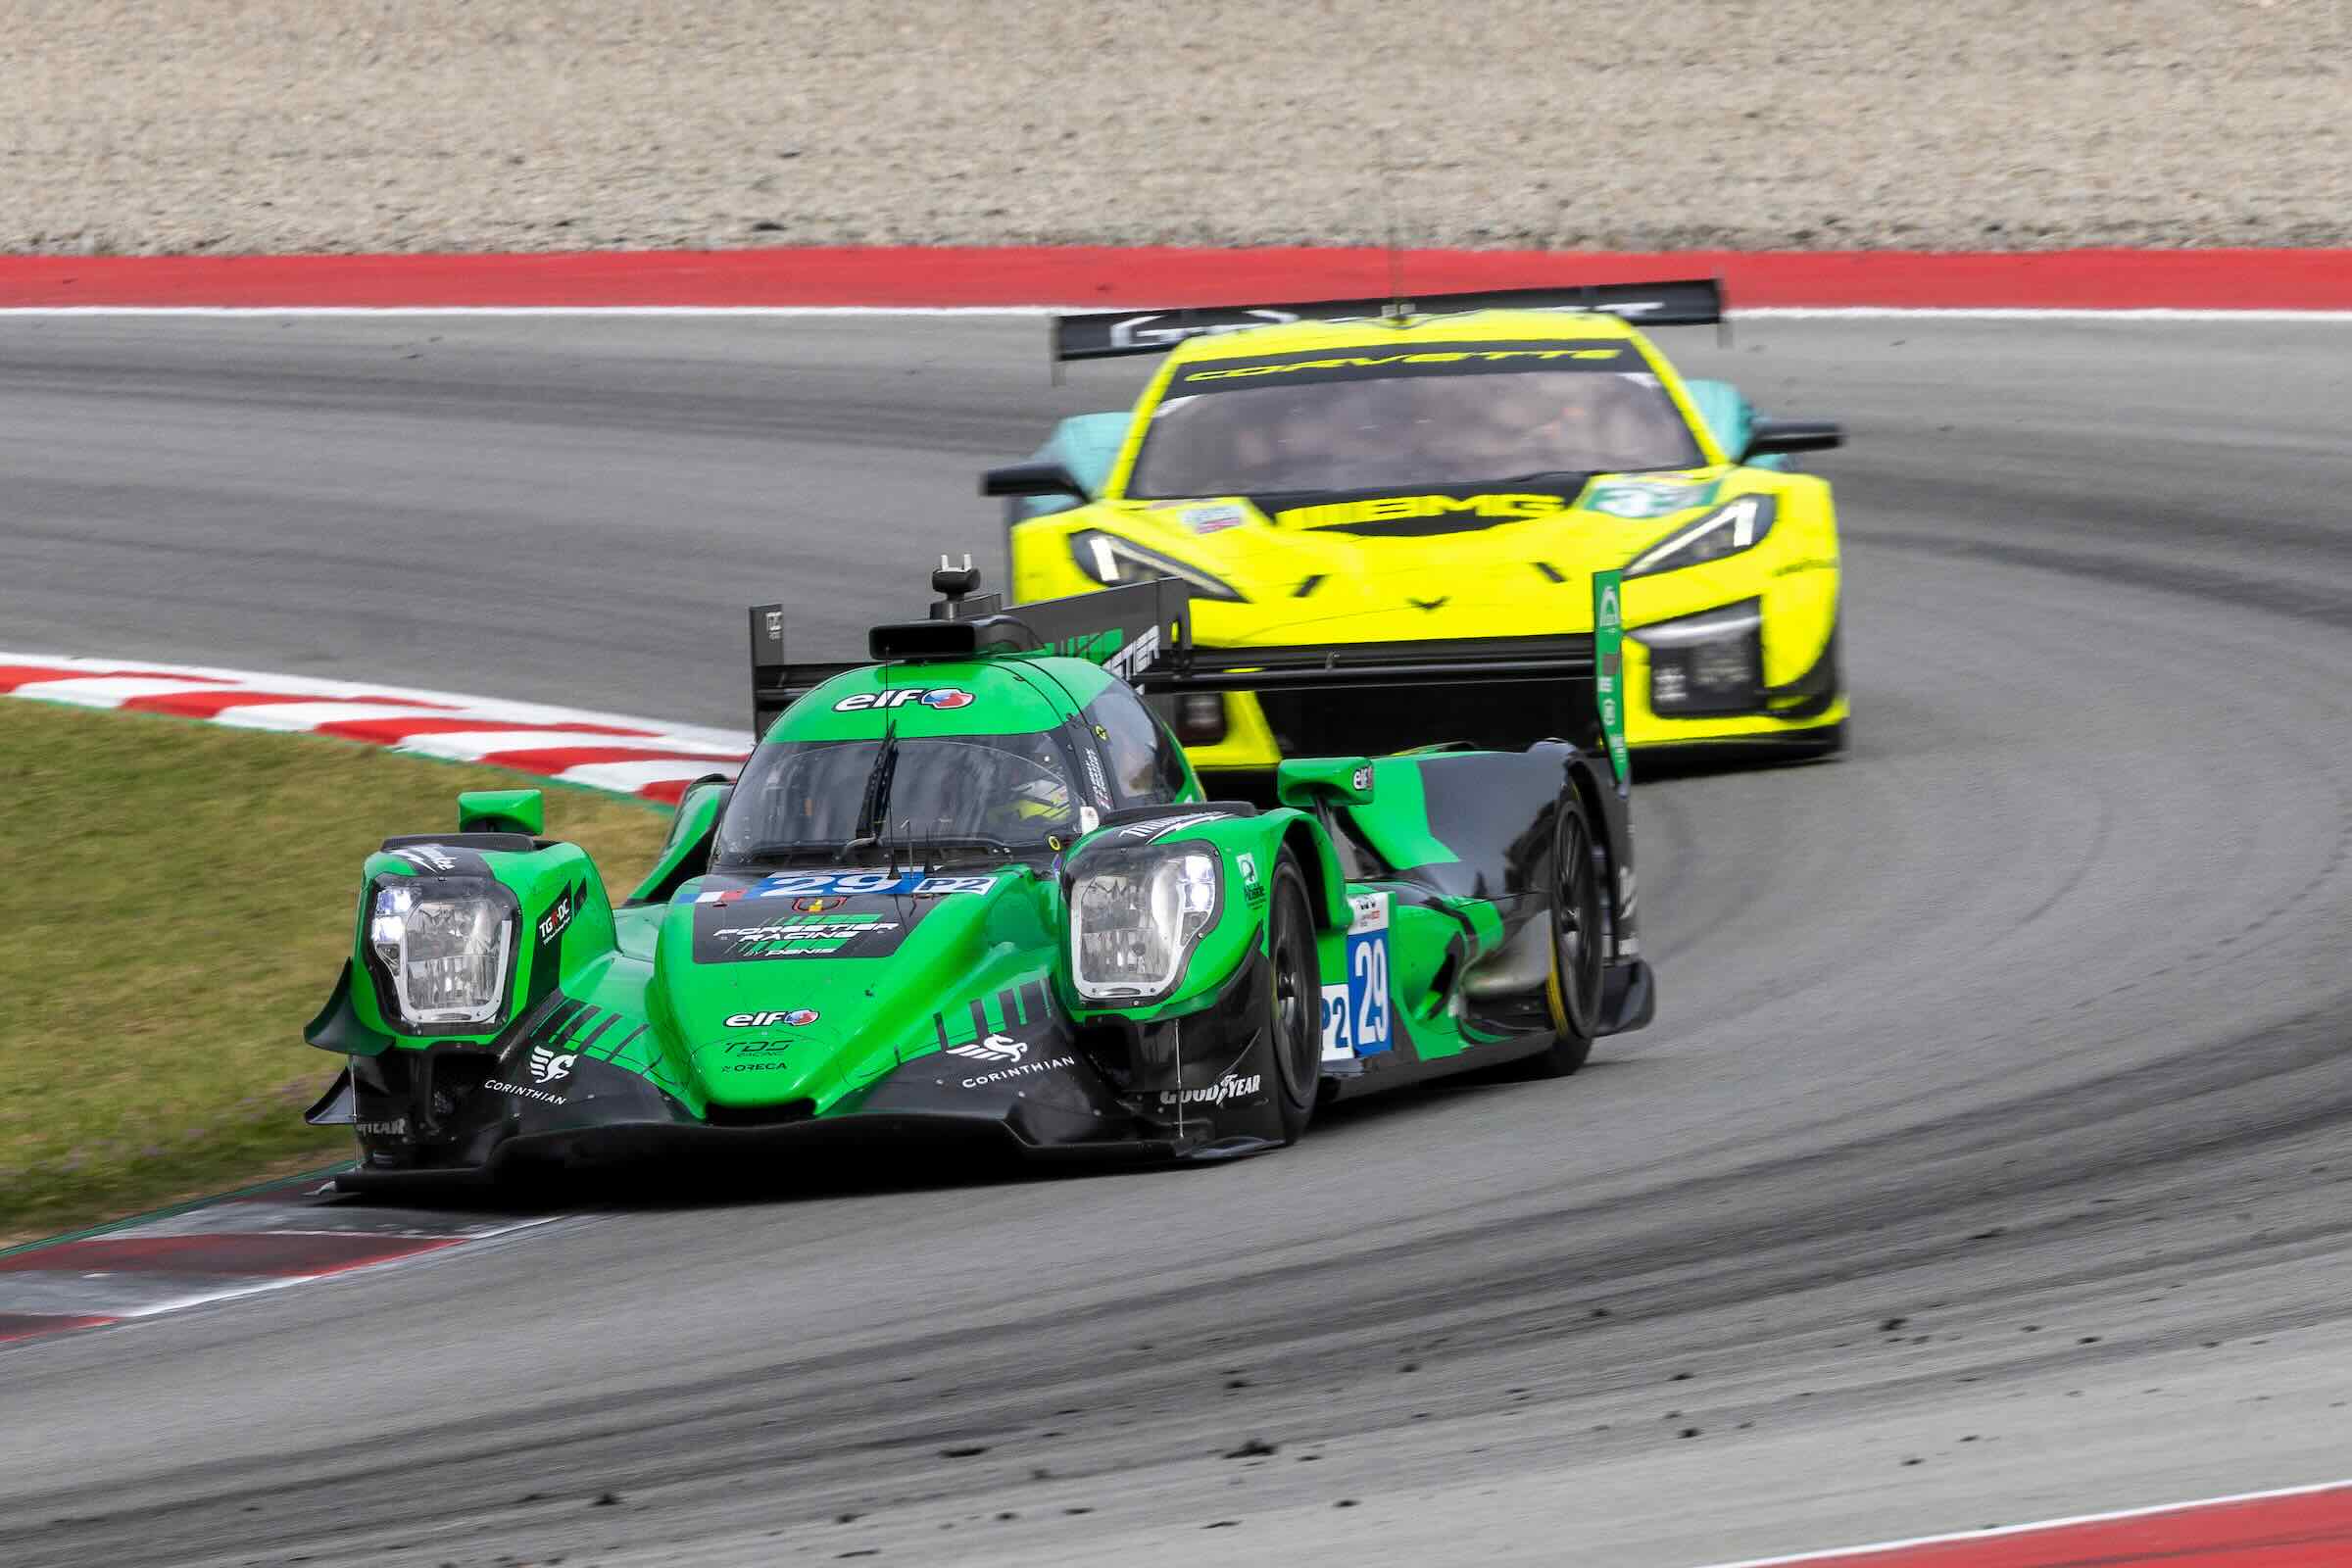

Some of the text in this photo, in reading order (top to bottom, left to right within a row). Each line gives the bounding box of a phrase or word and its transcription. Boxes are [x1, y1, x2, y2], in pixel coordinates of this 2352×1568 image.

[1184, 348, 1622, 382] CORVETTE
[834, 688, 925, 711] elf
[760, 874, 992, 897] 29 P2
[713, 923, 900, 937] FORESTIER
[739, 931, 860, 942] RACING
[1354, 938, 1389, 1046] 29
[724, 1011, 787, 1027] elf
[723, 1040, 794, 1054] TDS
[734, 1062, 788, 1073] ORECA
[961, 1056, 1075, 1089] CORINTHIAN
[484, 1079, 567, 1105] CORINTHIAN
